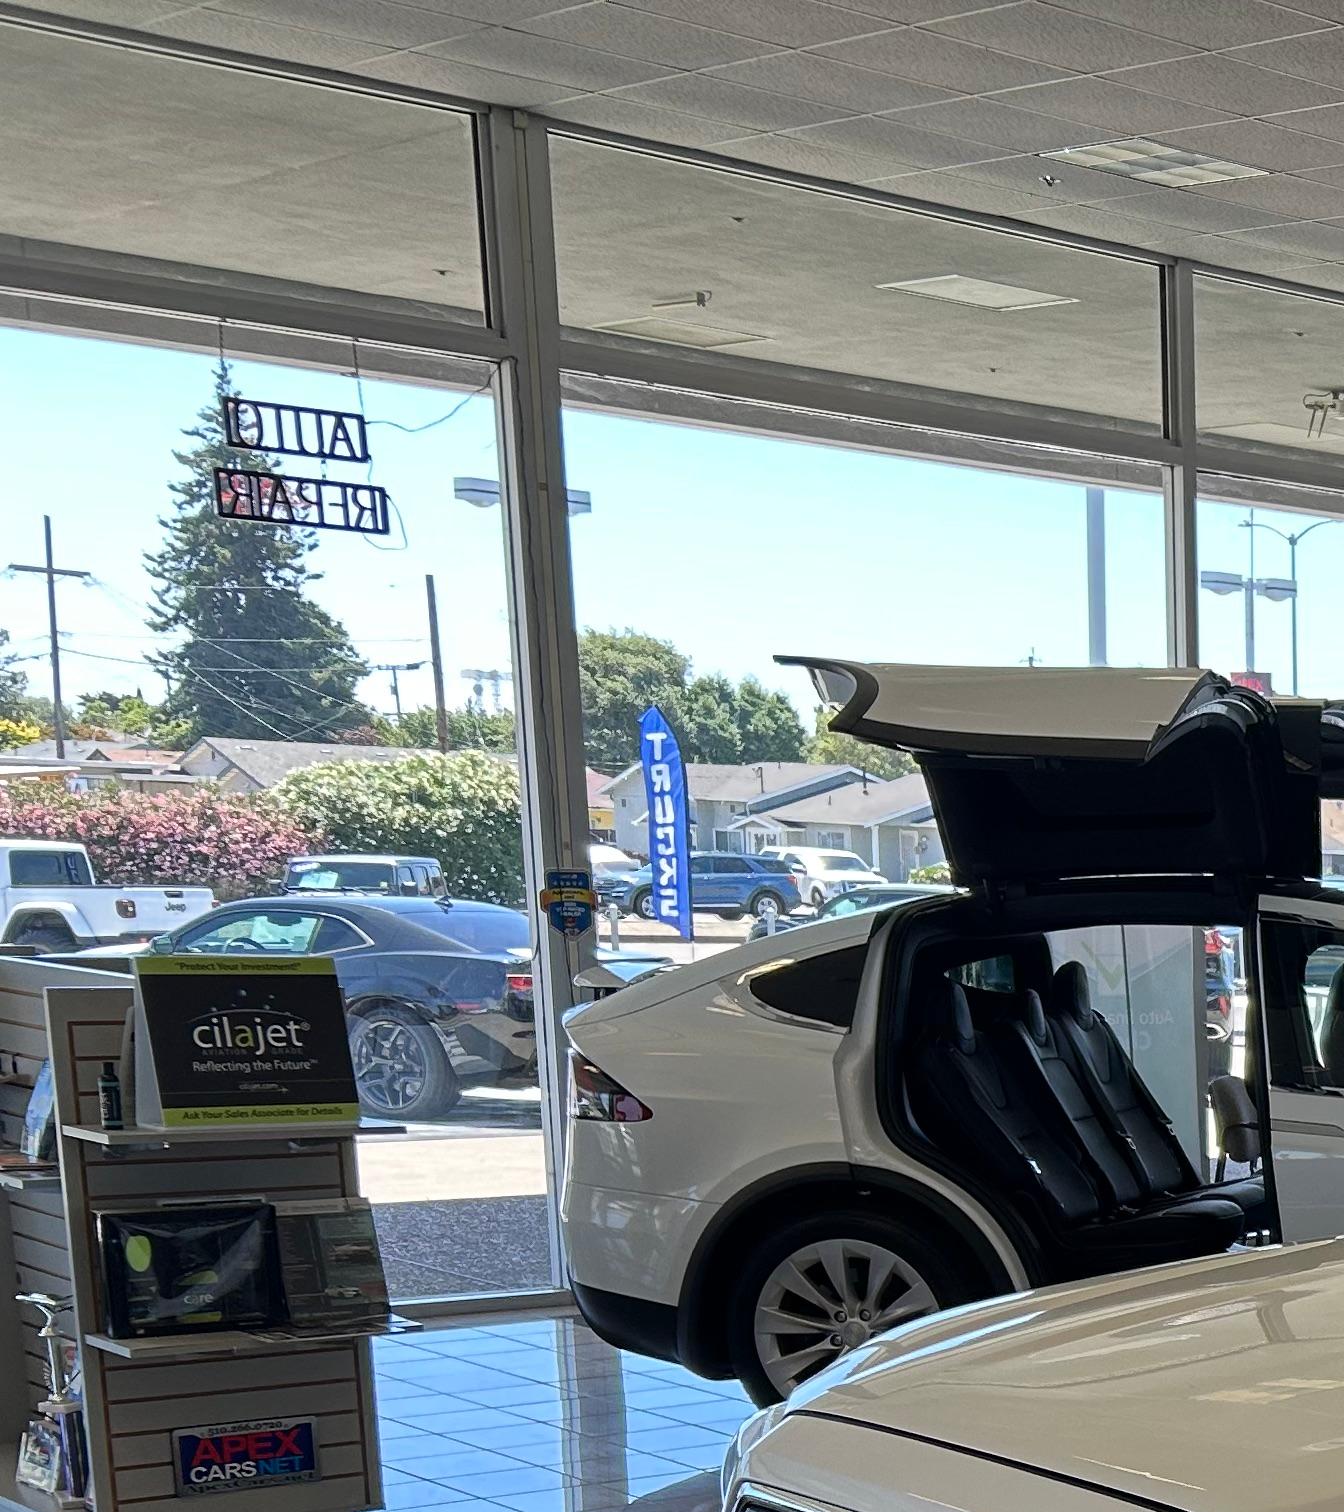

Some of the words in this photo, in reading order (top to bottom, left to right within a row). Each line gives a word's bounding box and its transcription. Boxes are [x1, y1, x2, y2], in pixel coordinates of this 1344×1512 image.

[164, 901, 187, 912] Jeep
[192, 1061, 250, 1074] Reflecting
[252, 1061, 272, 1071] the
[183, 1111, 200, 1120] Ask
[202, 1110, 224, 1119] Your
[226, 1109, 249, 1118] Sales
[251, 1107, 294, 1118] Associate
[296, 1107, 310, 1116] for
[311, 1106, 343, 1116] Details
[184, 1293, 214, 1306] care
[192, 1429, 303, 1467] APEX
